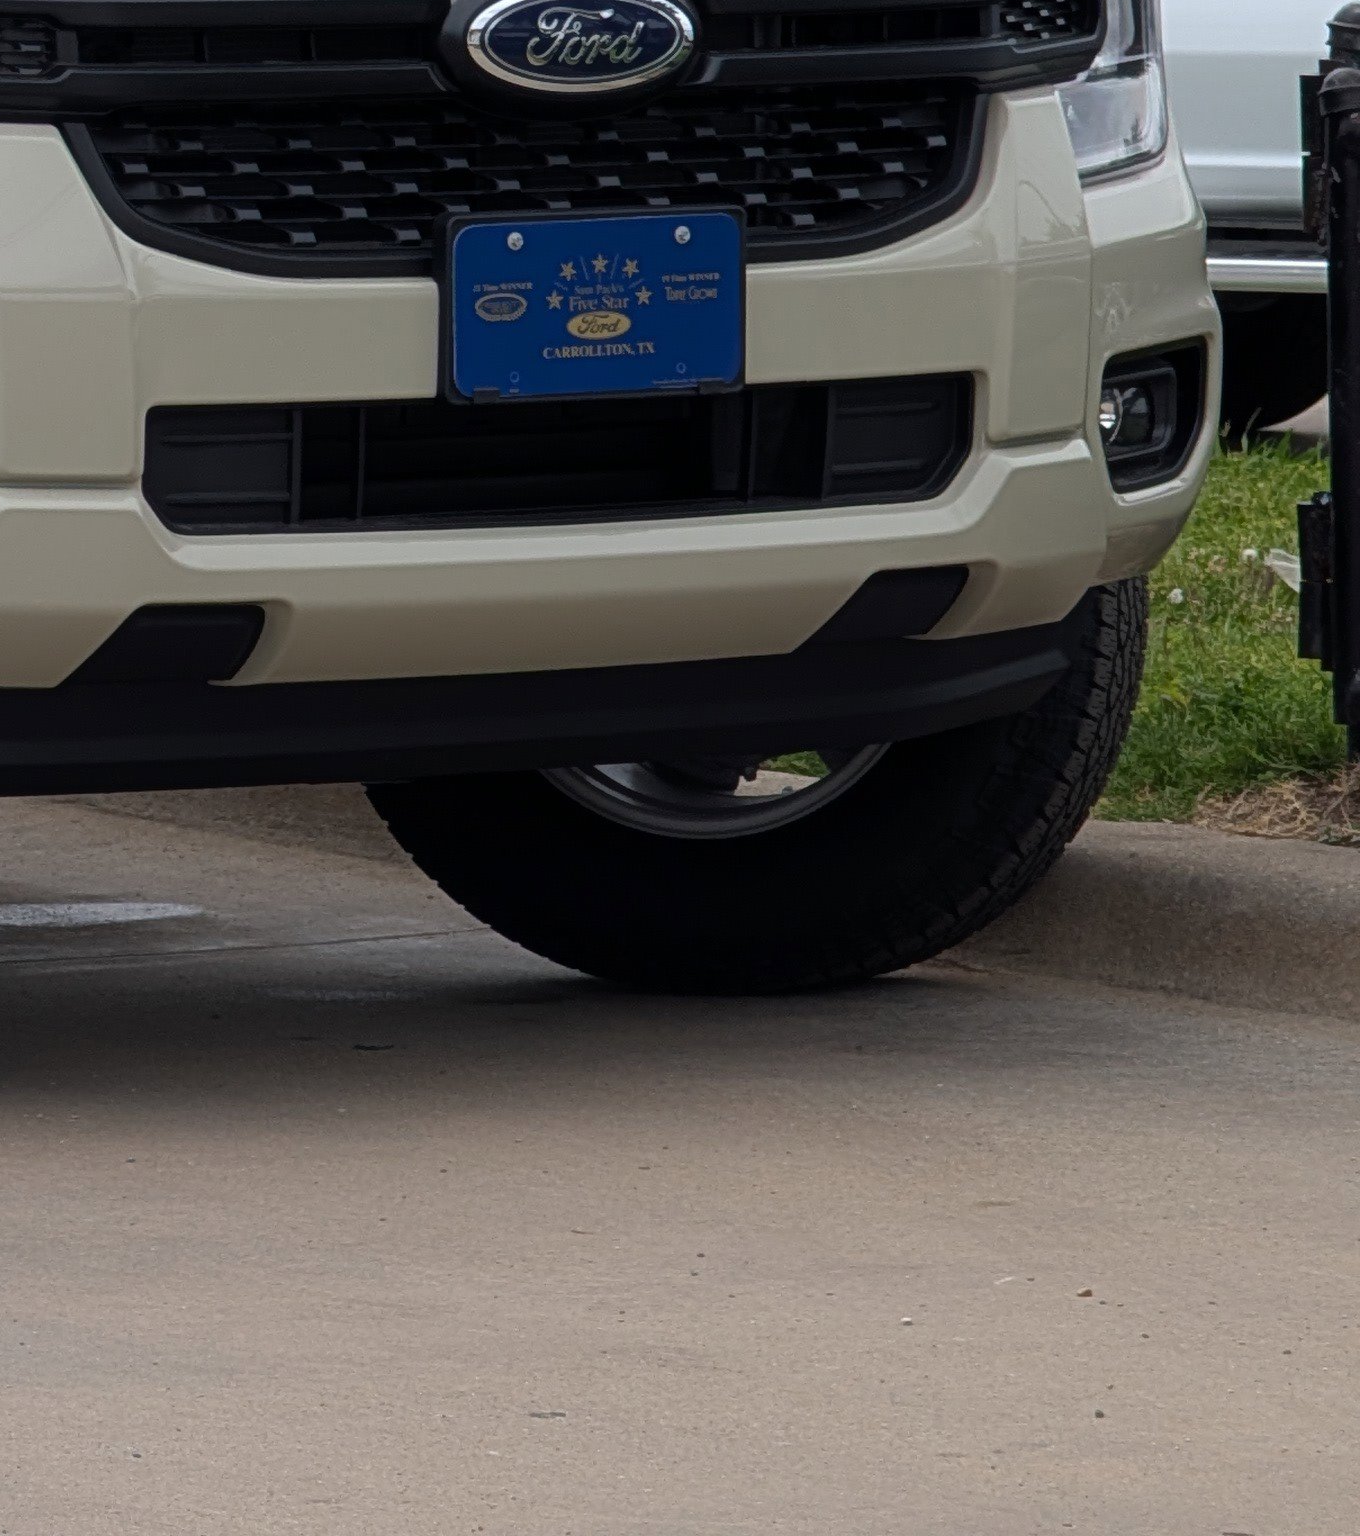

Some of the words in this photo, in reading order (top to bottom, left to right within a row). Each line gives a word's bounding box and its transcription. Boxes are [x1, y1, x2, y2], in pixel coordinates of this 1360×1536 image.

[526, 6, 645, 66] Ford
[568, 295, 598, 312] Five
[601, 294, 630, 310] Star
[577, 313, 621, 334] Ford
[636, 341, 656, 354] TX
